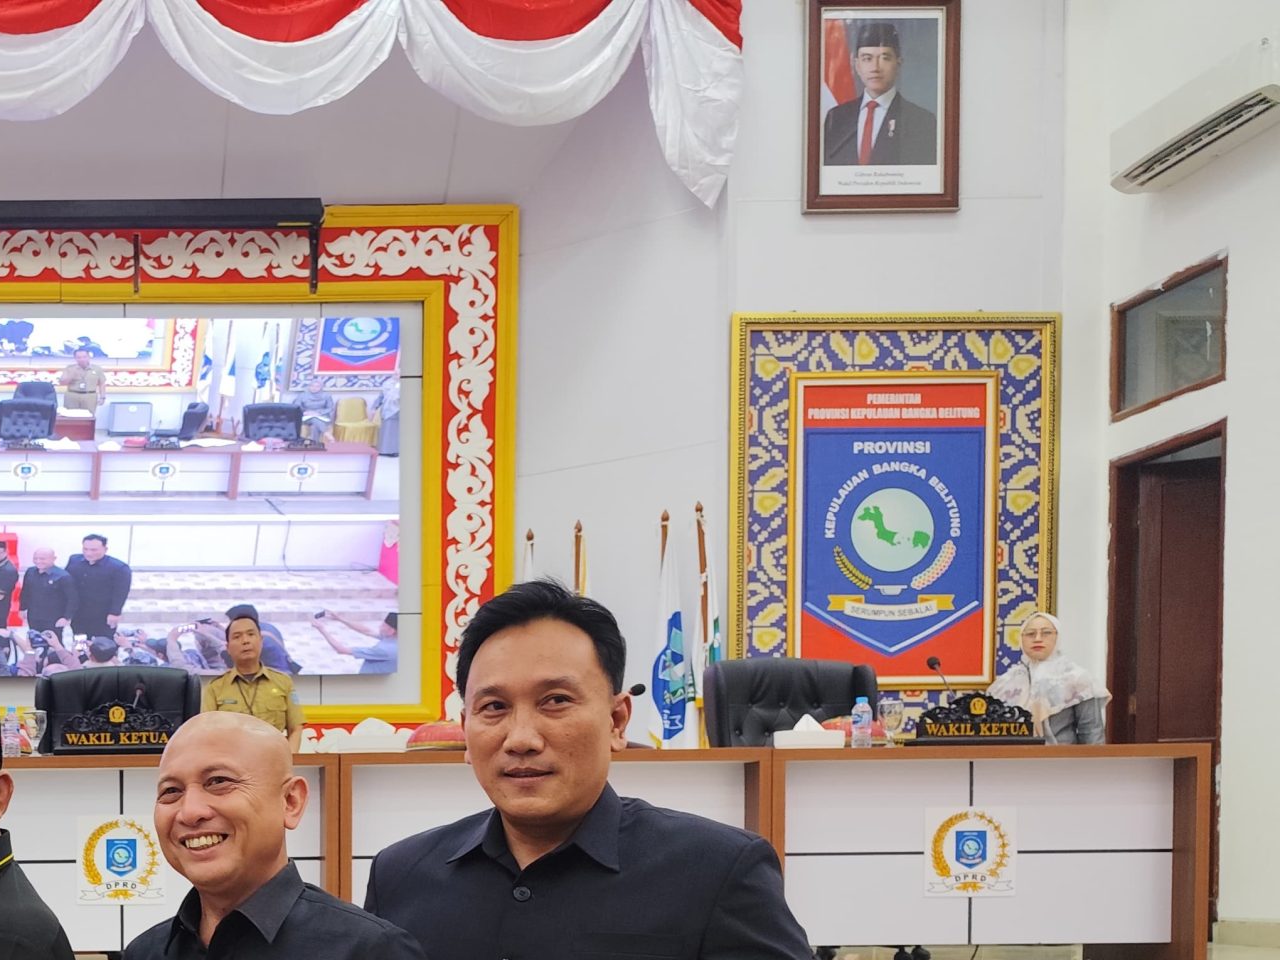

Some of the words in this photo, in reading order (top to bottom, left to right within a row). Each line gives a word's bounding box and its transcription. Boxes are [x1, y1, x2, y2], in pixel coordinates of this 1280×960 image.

[852, 440, 931, 454] PROVINSI
[824, 468, 870, 539] KEPULAUAN
[871, 460, 928, 480] BANGKA
[927, 475, 961, 538] BELITUNG
[850, 605, 896, 617] SERUMPUN
[897, 604, 933, 617] SEBALAI
[925, 723, 975, 736] WAKIL
[979, 723, 1029, 736] KETUA
[65, 732, 115, 745] WAKIL
[119, 731, 169, 744] KETUA
[954, 873, 987, 882] DPRD
[105, 881, 137, 890] DPRD
